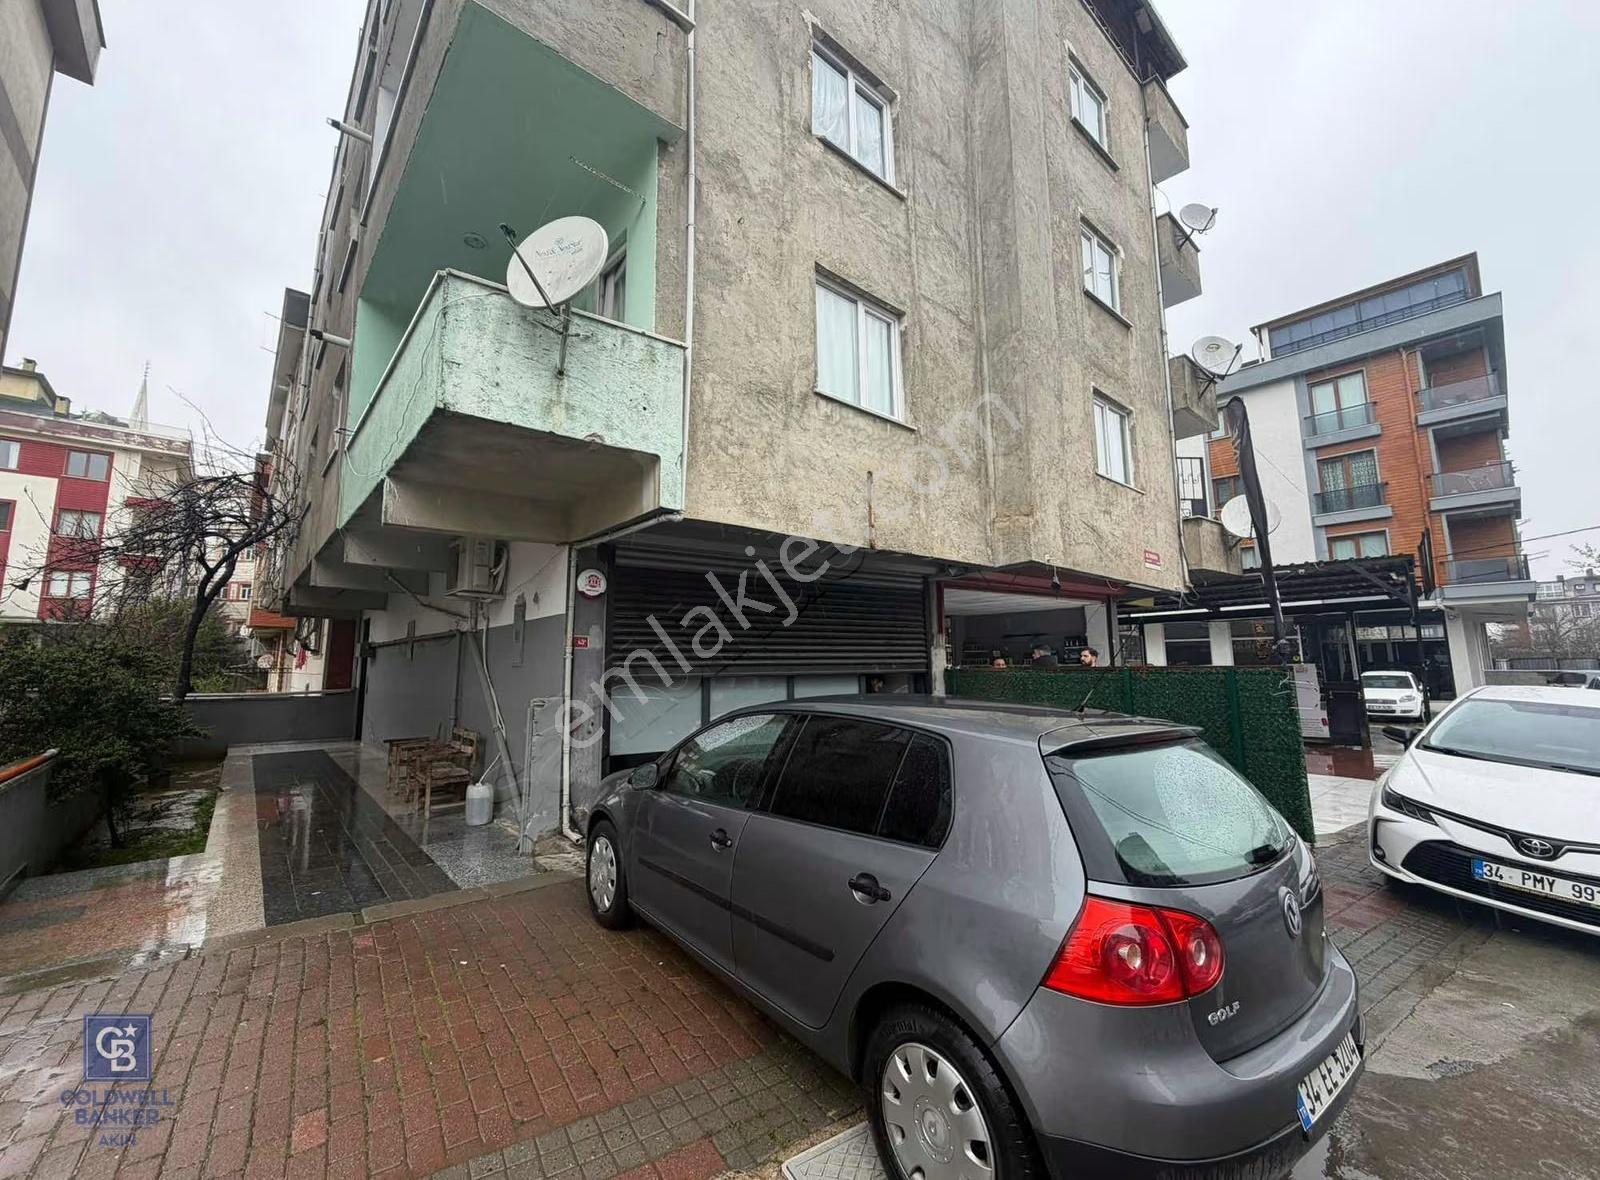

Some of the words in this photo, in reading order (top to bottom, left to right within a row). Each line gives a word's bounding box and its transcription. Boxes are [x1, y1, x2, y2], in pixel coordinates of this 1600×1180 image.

[1483, 863, 1504, 881] 34
[1521, 872, 1556, 892] PMY
[1571, 884, 1600, 902] 99
[1208, 1001, 1240, 1026] GOLF
[1300, 1073, 1323, 1115] 34
[1317, 1060, 1339, 1096] EE
